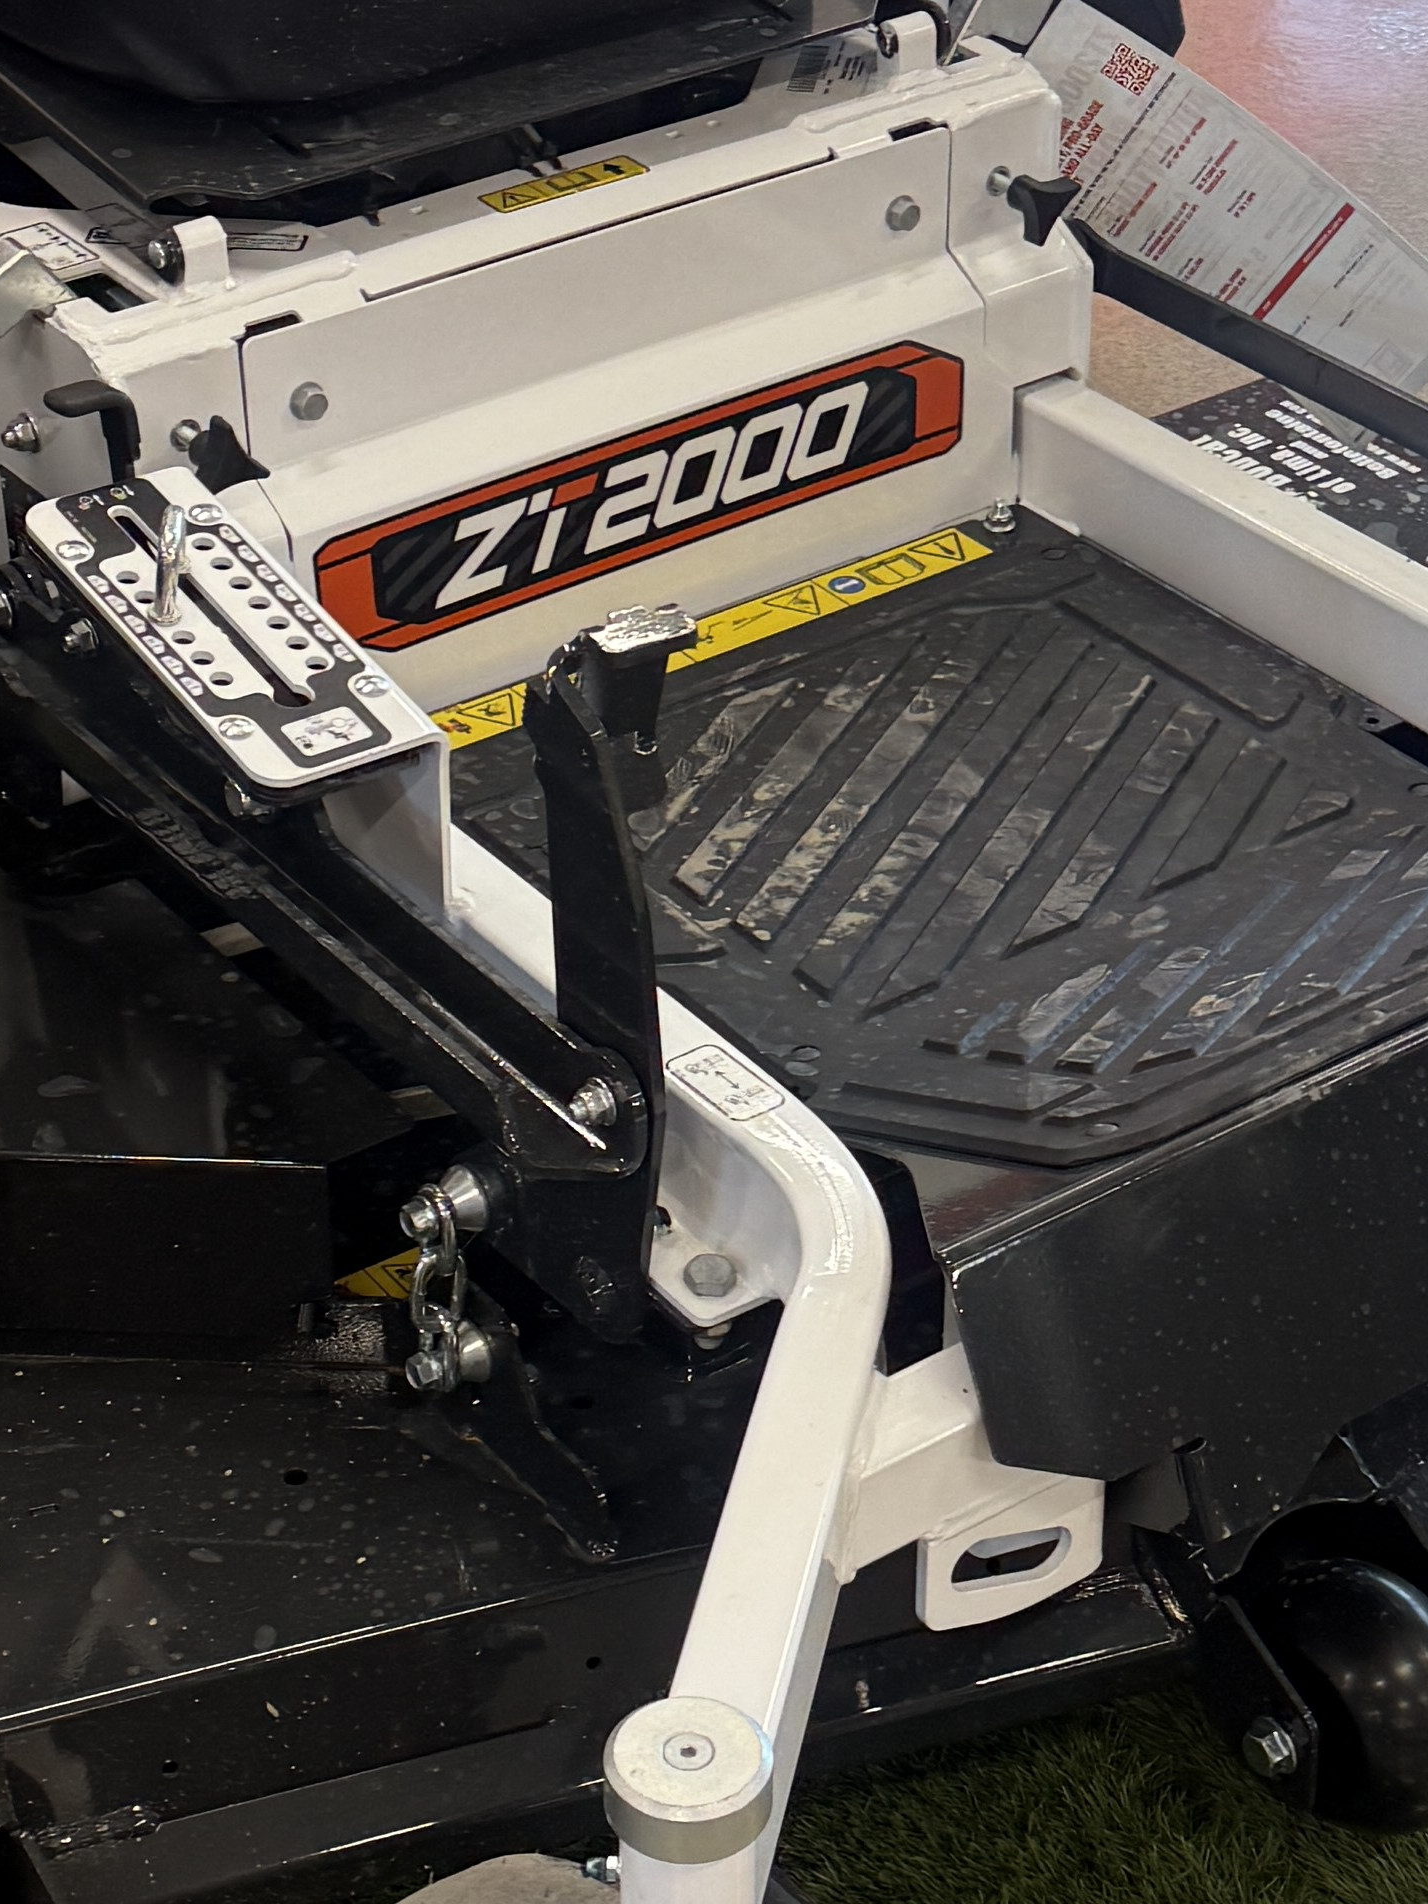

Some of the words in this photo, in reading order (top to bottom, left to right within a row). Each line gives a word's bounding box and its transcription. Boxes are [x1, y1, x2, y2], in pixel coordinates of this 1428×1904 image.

[1227, 423, 1273, 451] Inc.
[1289, 440, 1329, 459] and
[1270, 445, 1332, 482] Lima,
